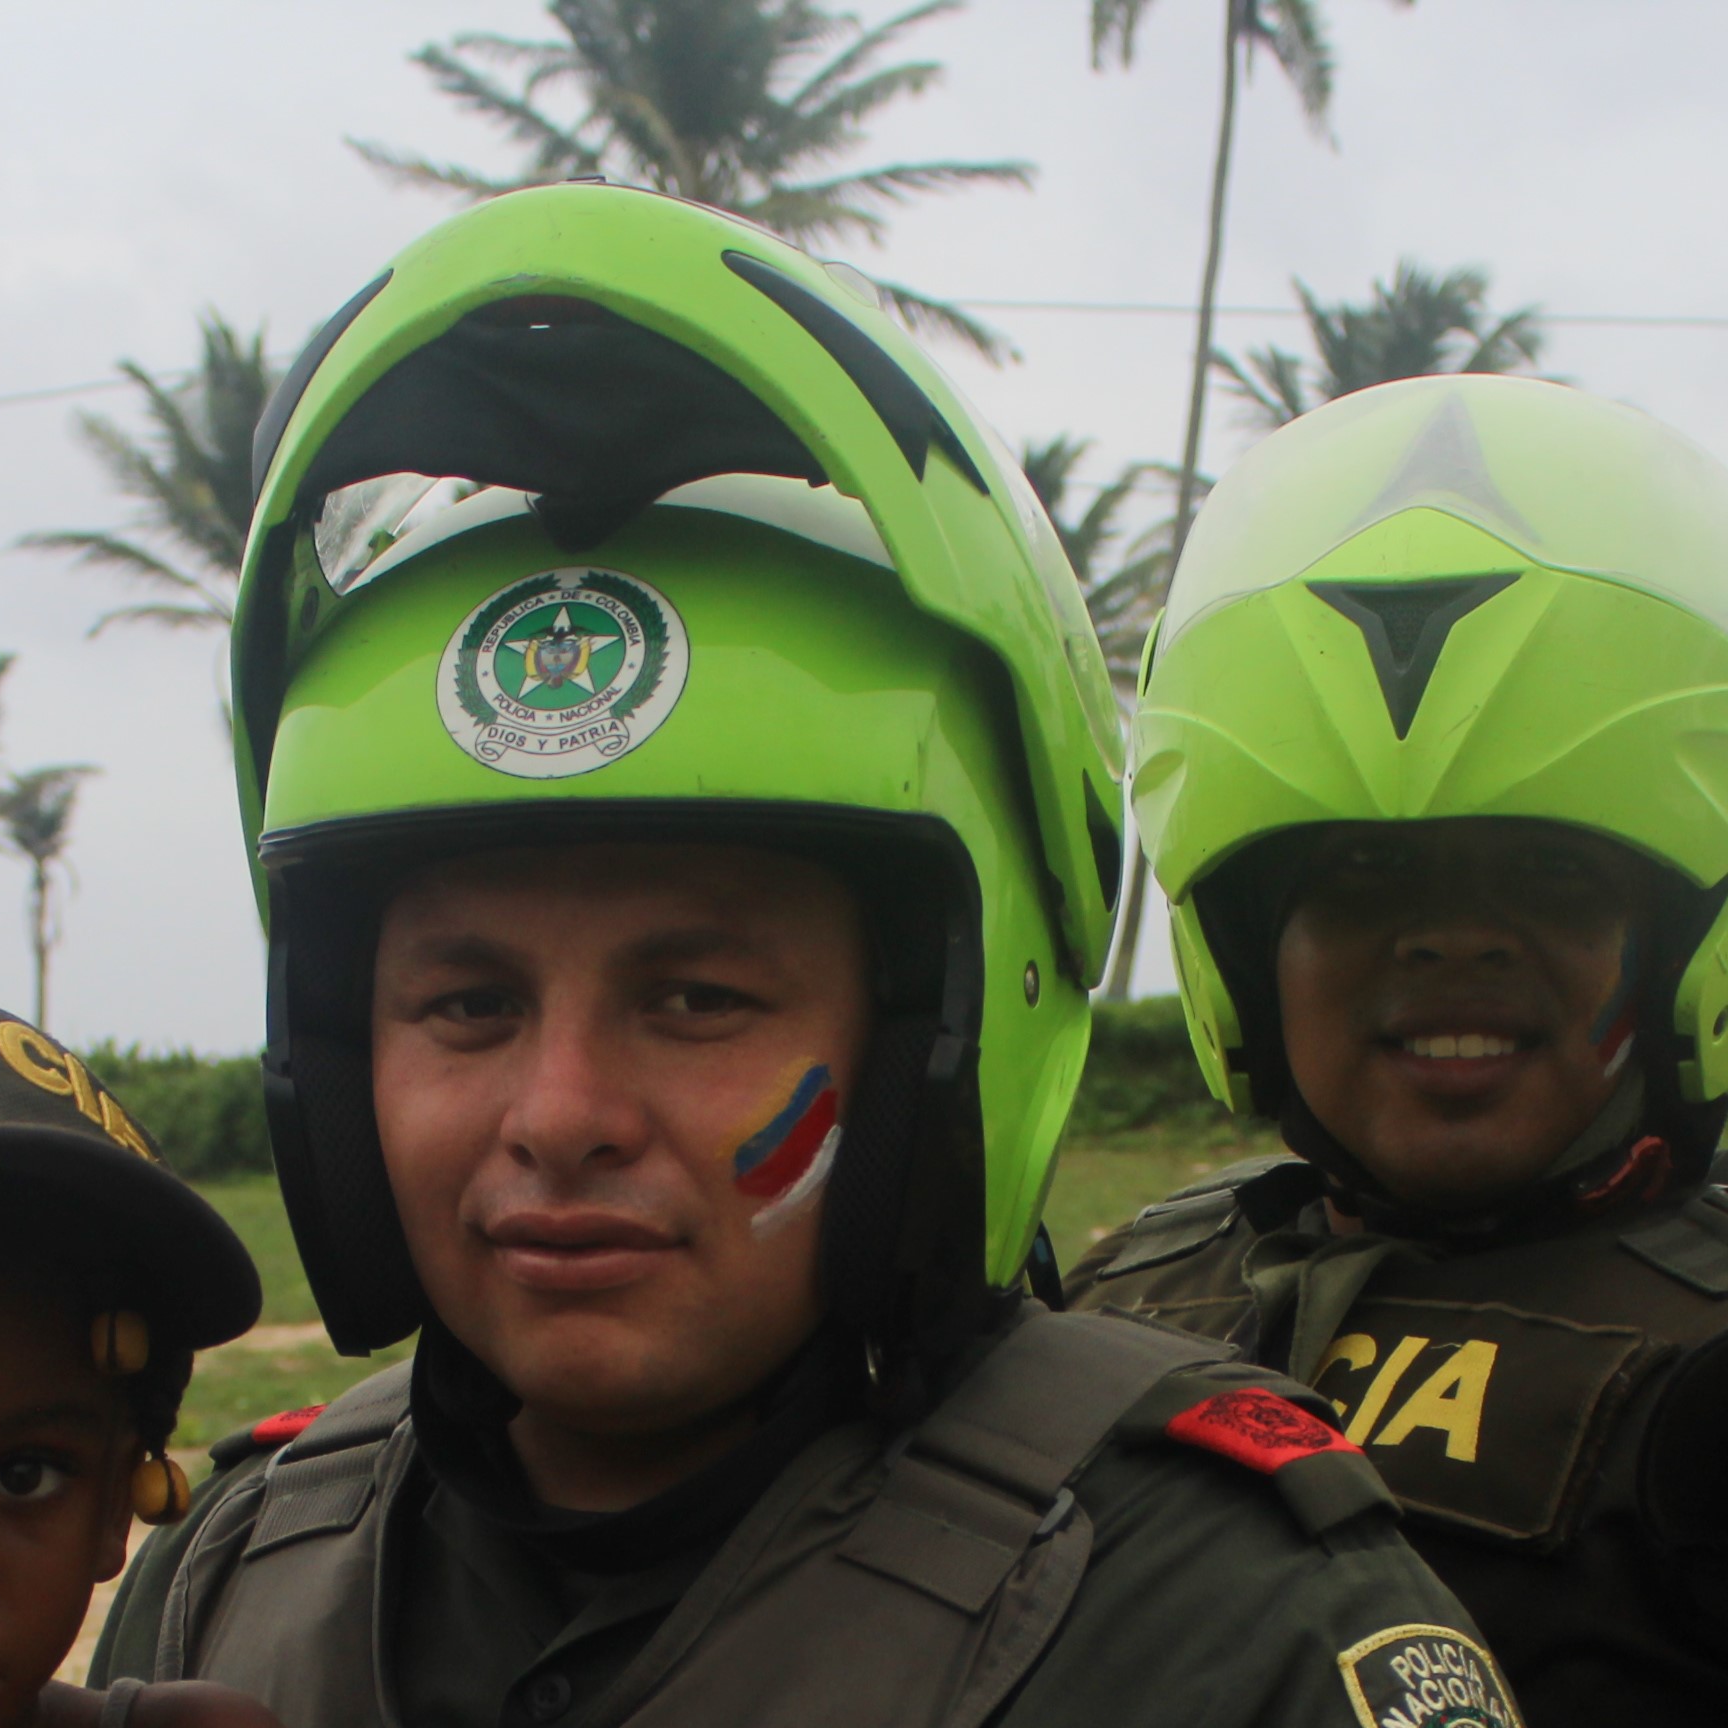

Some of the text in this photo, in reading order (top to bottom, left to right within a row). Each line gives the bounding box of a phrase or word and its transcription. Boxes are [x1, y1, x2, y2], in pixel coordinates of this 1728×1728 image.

[481, 590, 642, 653] REPUBLICA DE COLOMBIA
[493, 686, 623, 723] POLICIA NACIONAL
[487, 720, 620, 751] DIOS Y PATRIA
